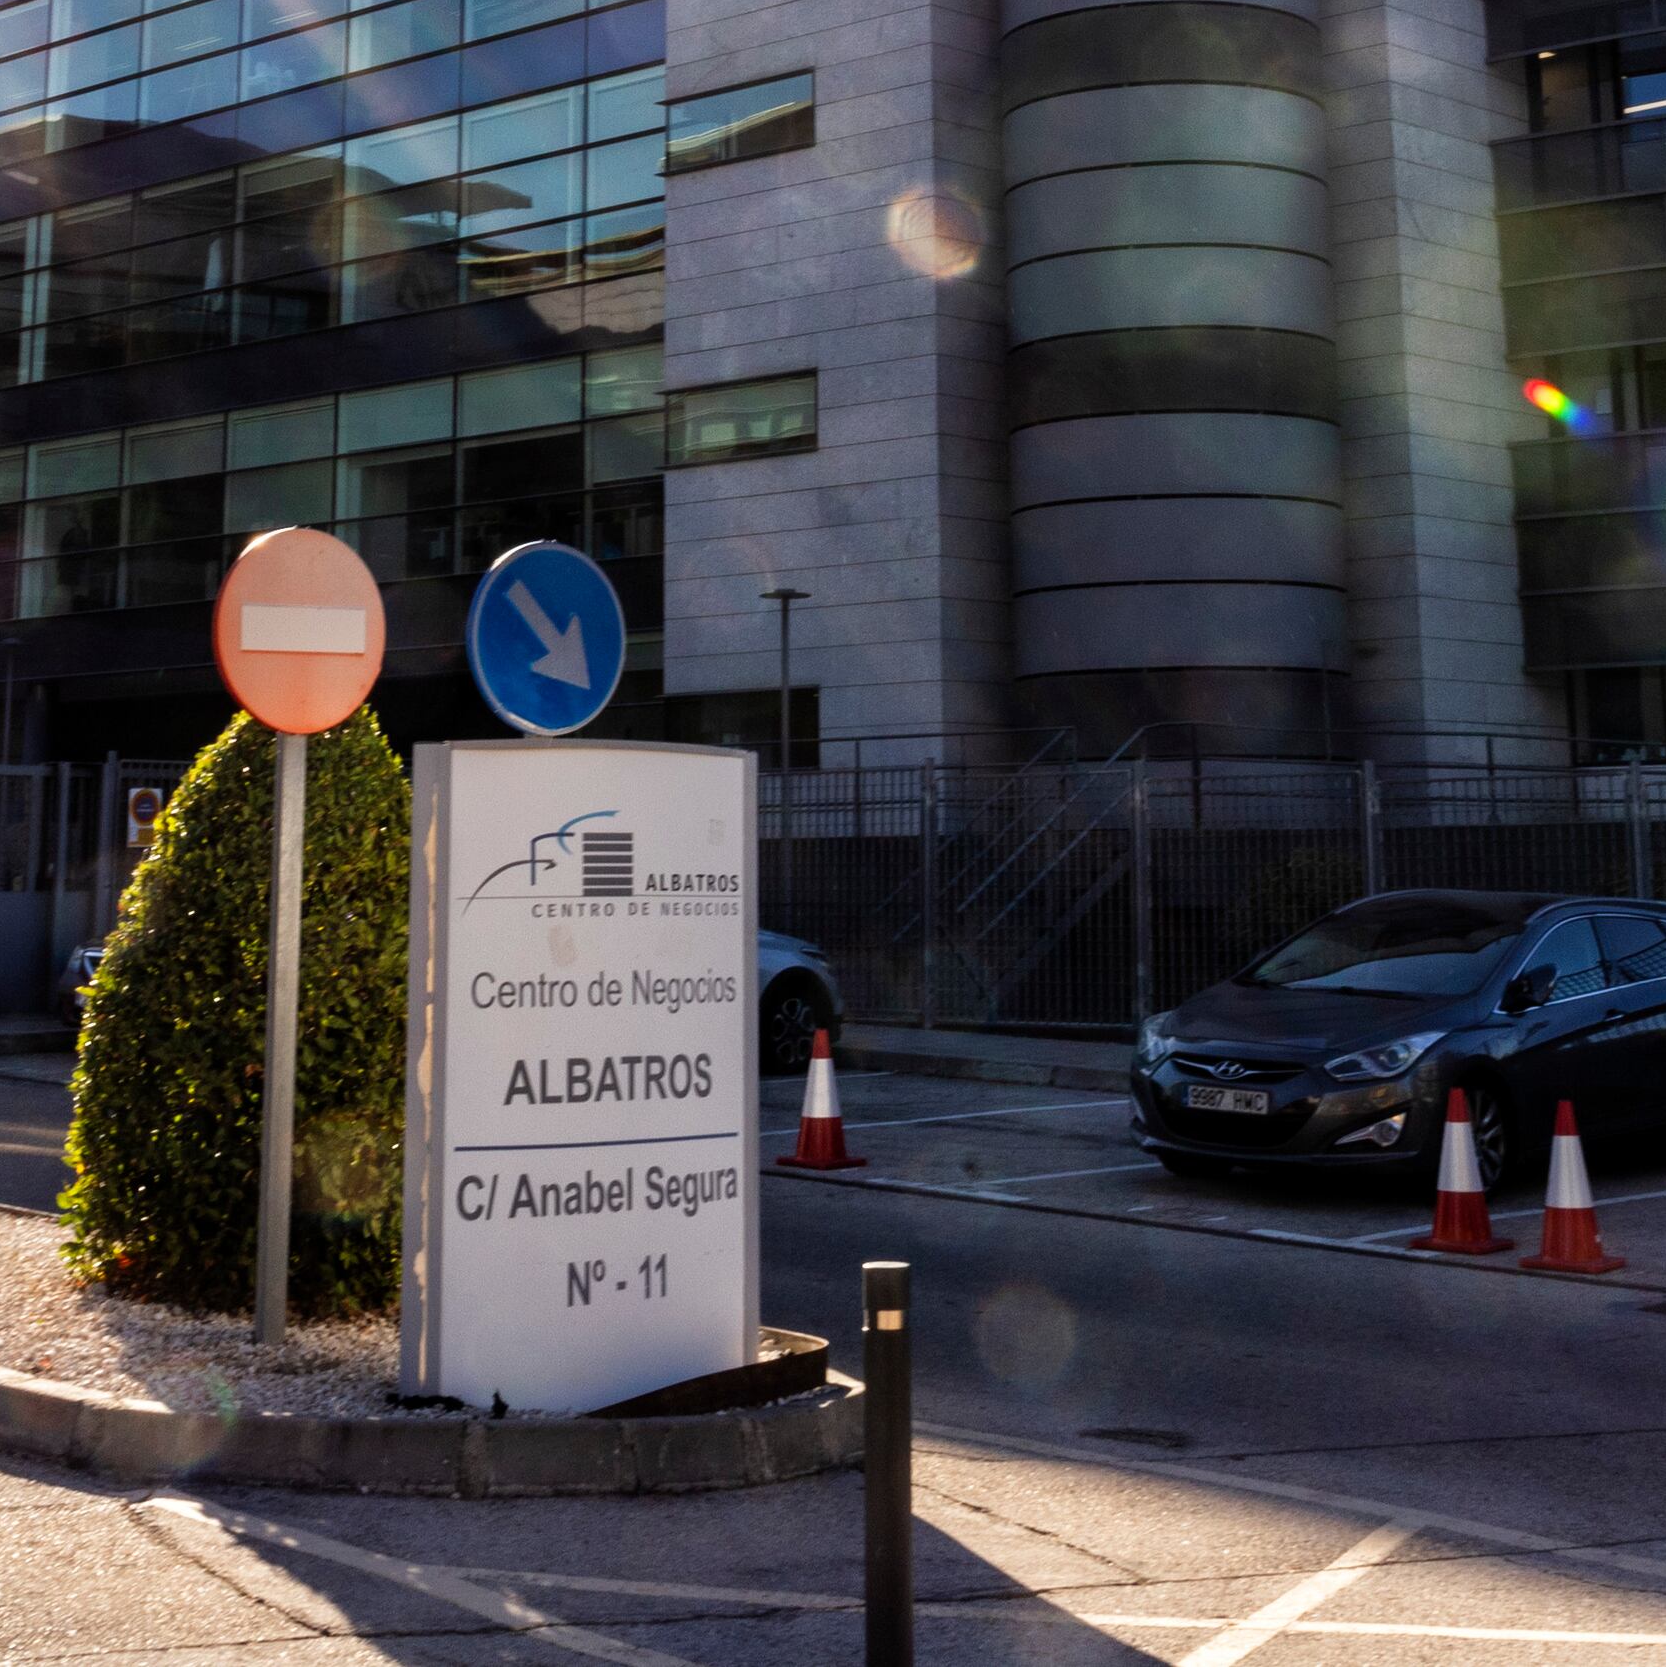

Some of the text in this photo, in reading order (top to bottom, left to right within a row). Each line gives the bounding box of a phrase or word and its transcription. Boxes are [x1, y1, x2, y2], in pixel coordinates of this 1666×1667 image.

[645, 873, 740, 893] ALBATROS
[532, 901, 740, 918] CENTRO DE NEGOCIOS
[471, 968, 737, 1014] Centro de Negocios
[503, 1052, 712, 1106] ALBATROS
[456, 1165, 738, 1221] C/ Anabel Segura
[638, 1252, 668, 1299] 11
